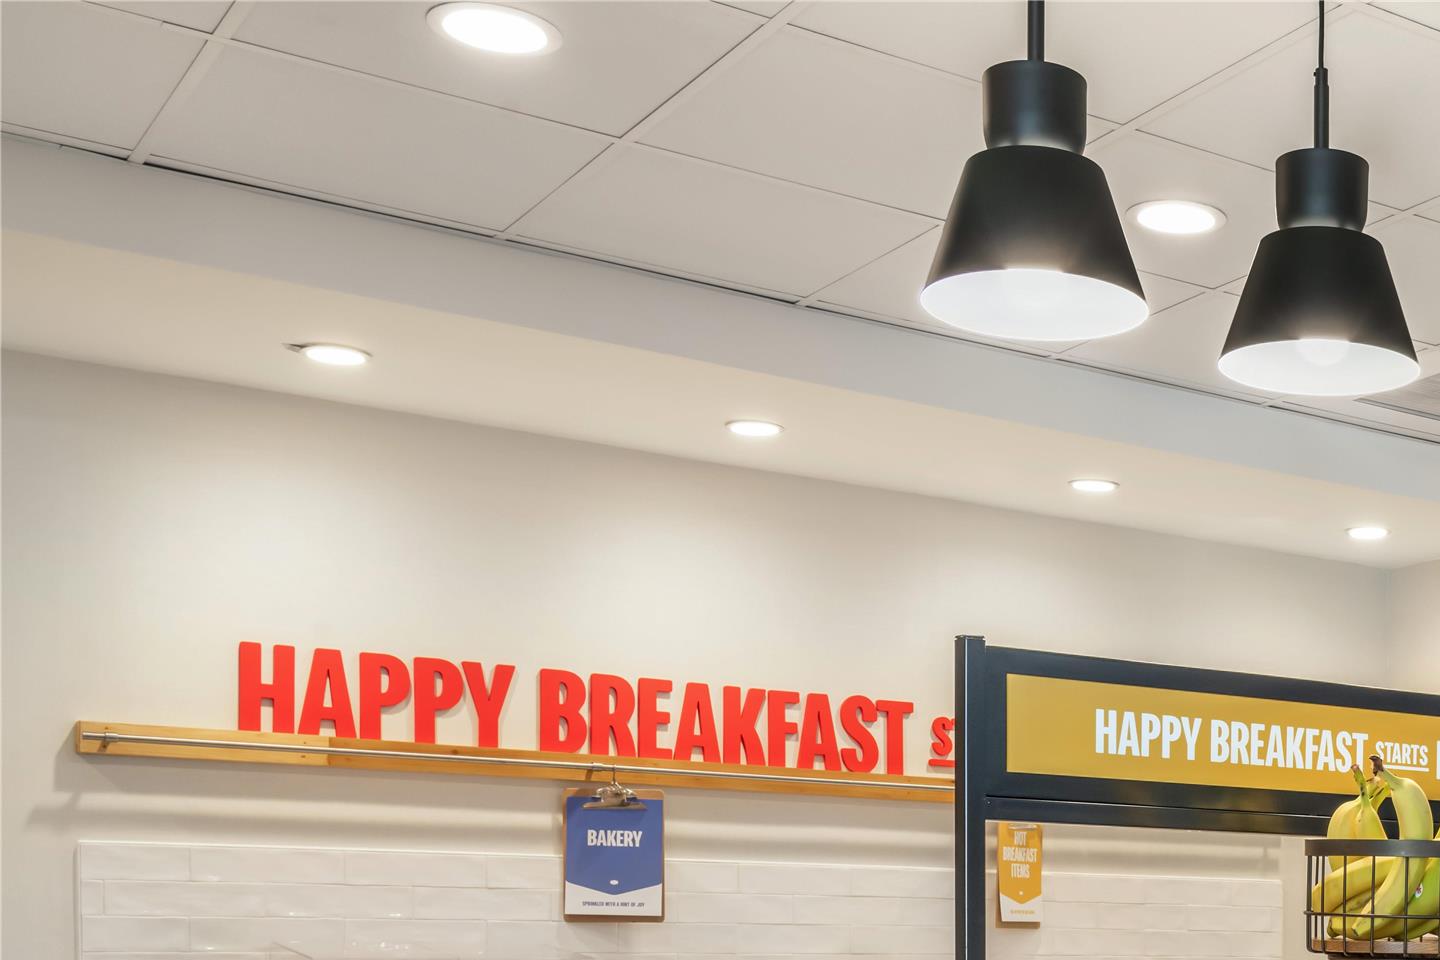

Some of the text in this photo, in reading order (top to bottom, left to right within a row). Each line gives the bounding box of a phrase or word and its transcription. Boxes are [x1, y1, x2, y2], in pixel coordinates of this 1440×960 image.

[238, 641, 516, 749] HAPPY
[539, 668, 914, 776] BREAKFAST
[1095, 708, 1202, 761] HAPPY
[1210, 719, 1368, 774] BREAKFAST
[1375, 740, 1429, 767] STARTS
[587, 829, 643, 847] BAKERY
